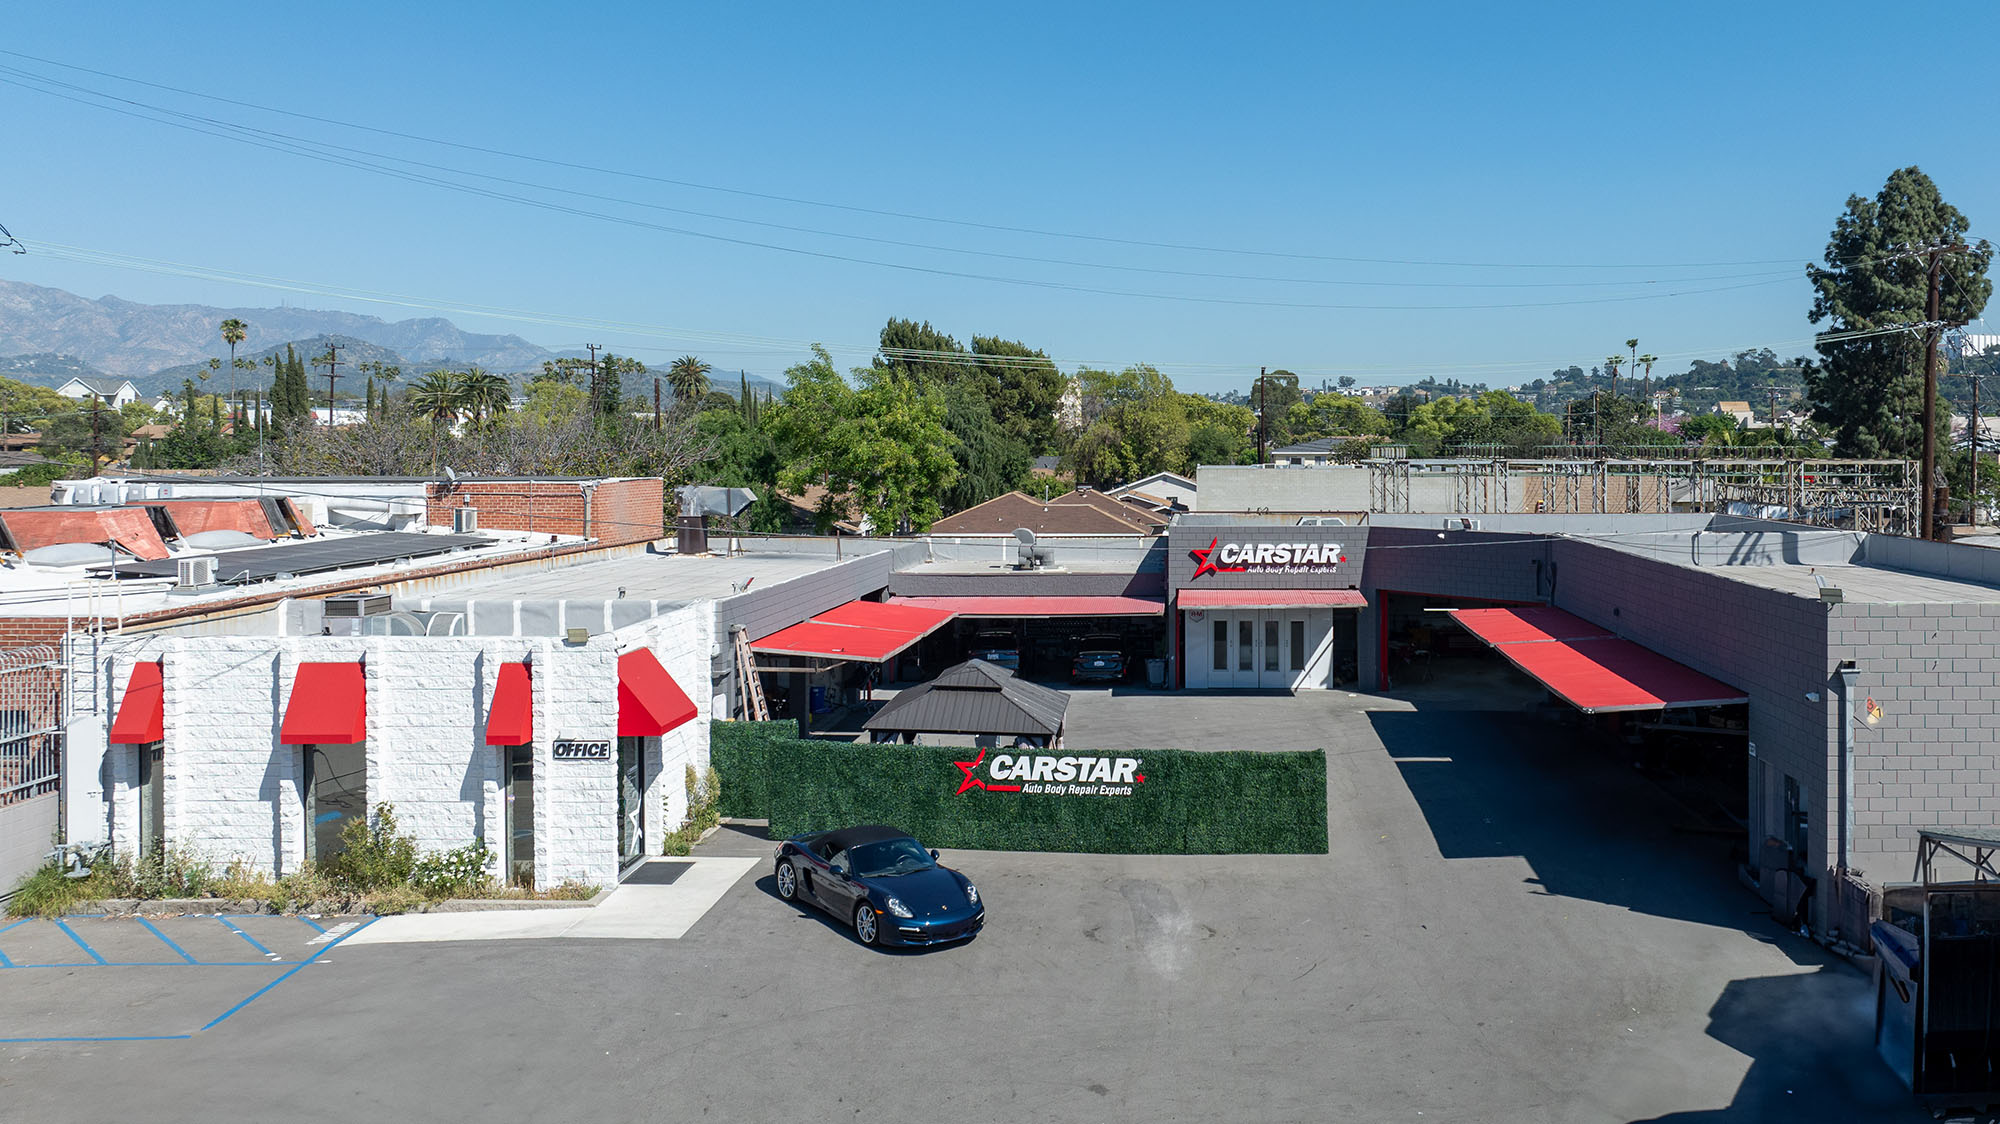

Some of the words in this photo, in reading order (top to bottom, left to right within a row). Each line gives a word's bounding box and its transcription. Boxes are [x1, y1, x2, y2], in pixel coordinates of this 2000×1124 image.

[1220, 543, 1341, 564] CARSTAR
[1247, 565, 1264, 573] Auto
[1265, 565, 1283, 575] Body
[1285, 565, 1309, 575] Repair
[1310, 565, 1337, 575] Experts
[555, 743, 608, 757] OFFICE
[989, 754, 1138, 783] CARSTAR
[1022, 782, 1043, 794] Auto
[1044, 784, 1066, 796] Body
[1068, 785, 1098, 797] Repair
[1100, 785, 1132, 797] Experts
